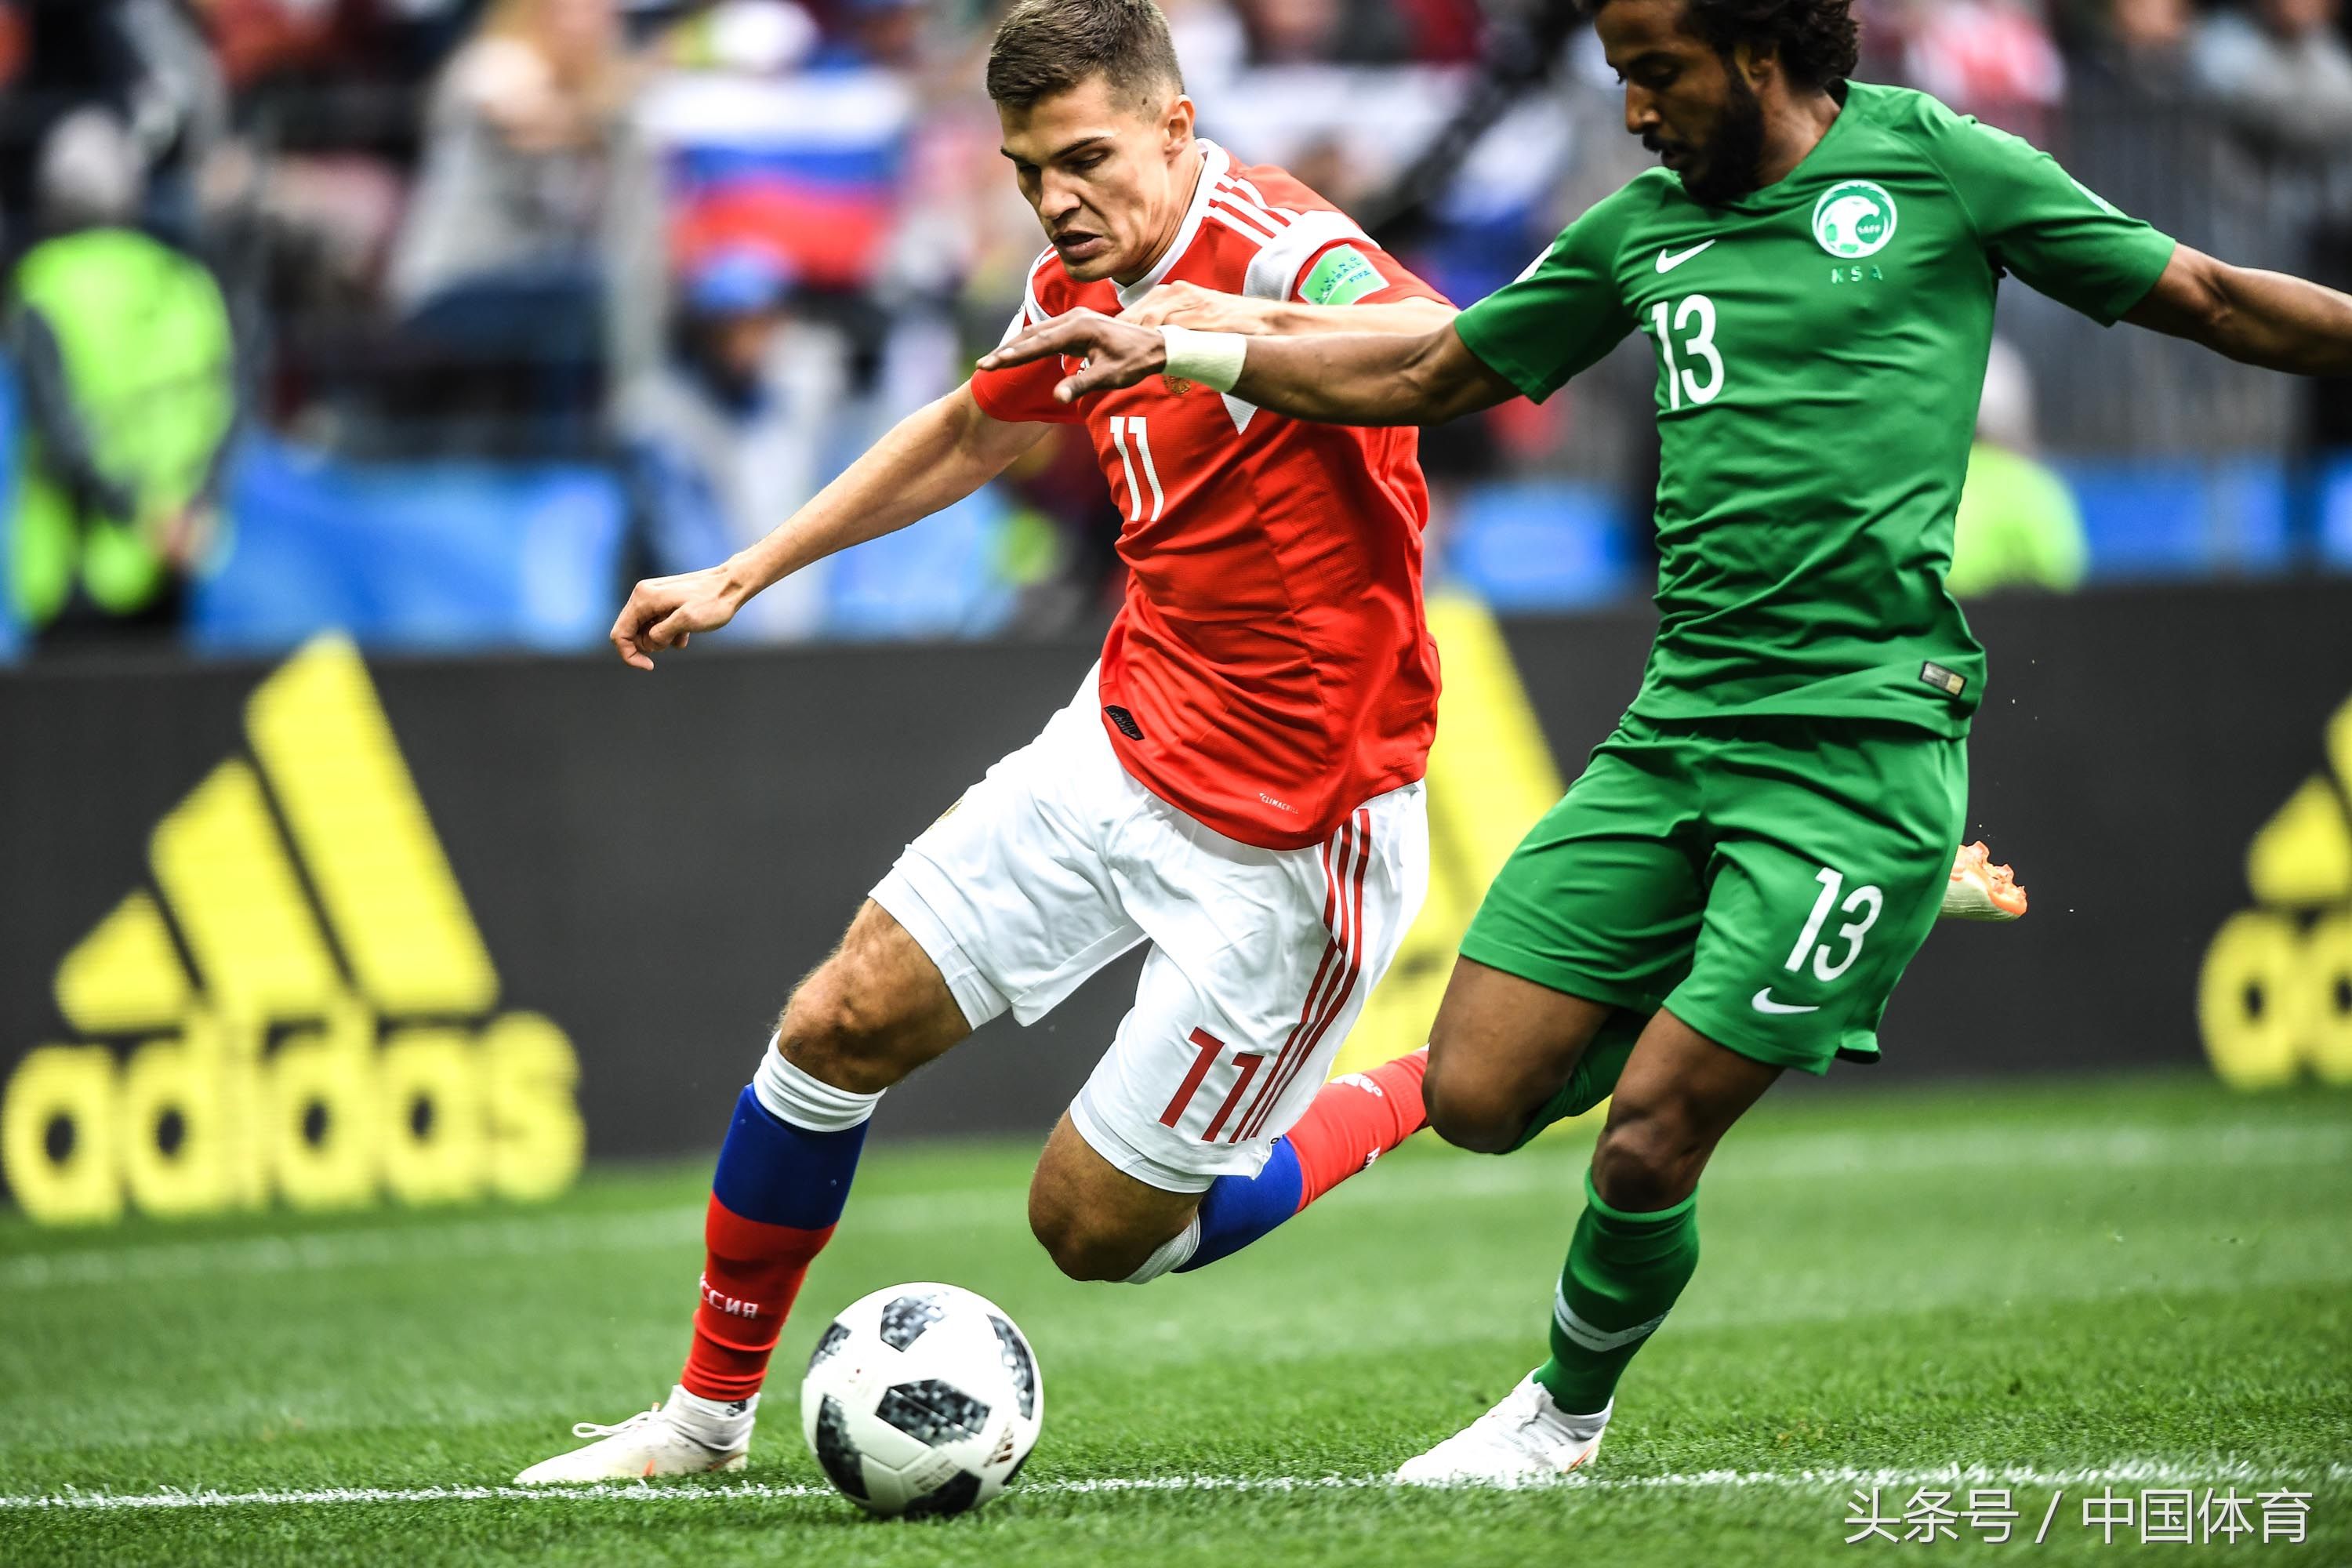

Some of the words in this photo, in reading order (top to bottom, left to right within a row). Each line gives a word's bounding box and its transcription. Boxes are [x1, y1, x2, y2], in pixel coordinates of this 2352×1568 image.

[1831, 265, 1883, 283] KSA
[1651, 293, 1725, 411] 13
[1109, 416, 1164, 522] 11
[1784, 866, 1884, 982] 13
[2, 1007, 586, 1225] adidas
[1159, 1026, 1265, 1142] 11
